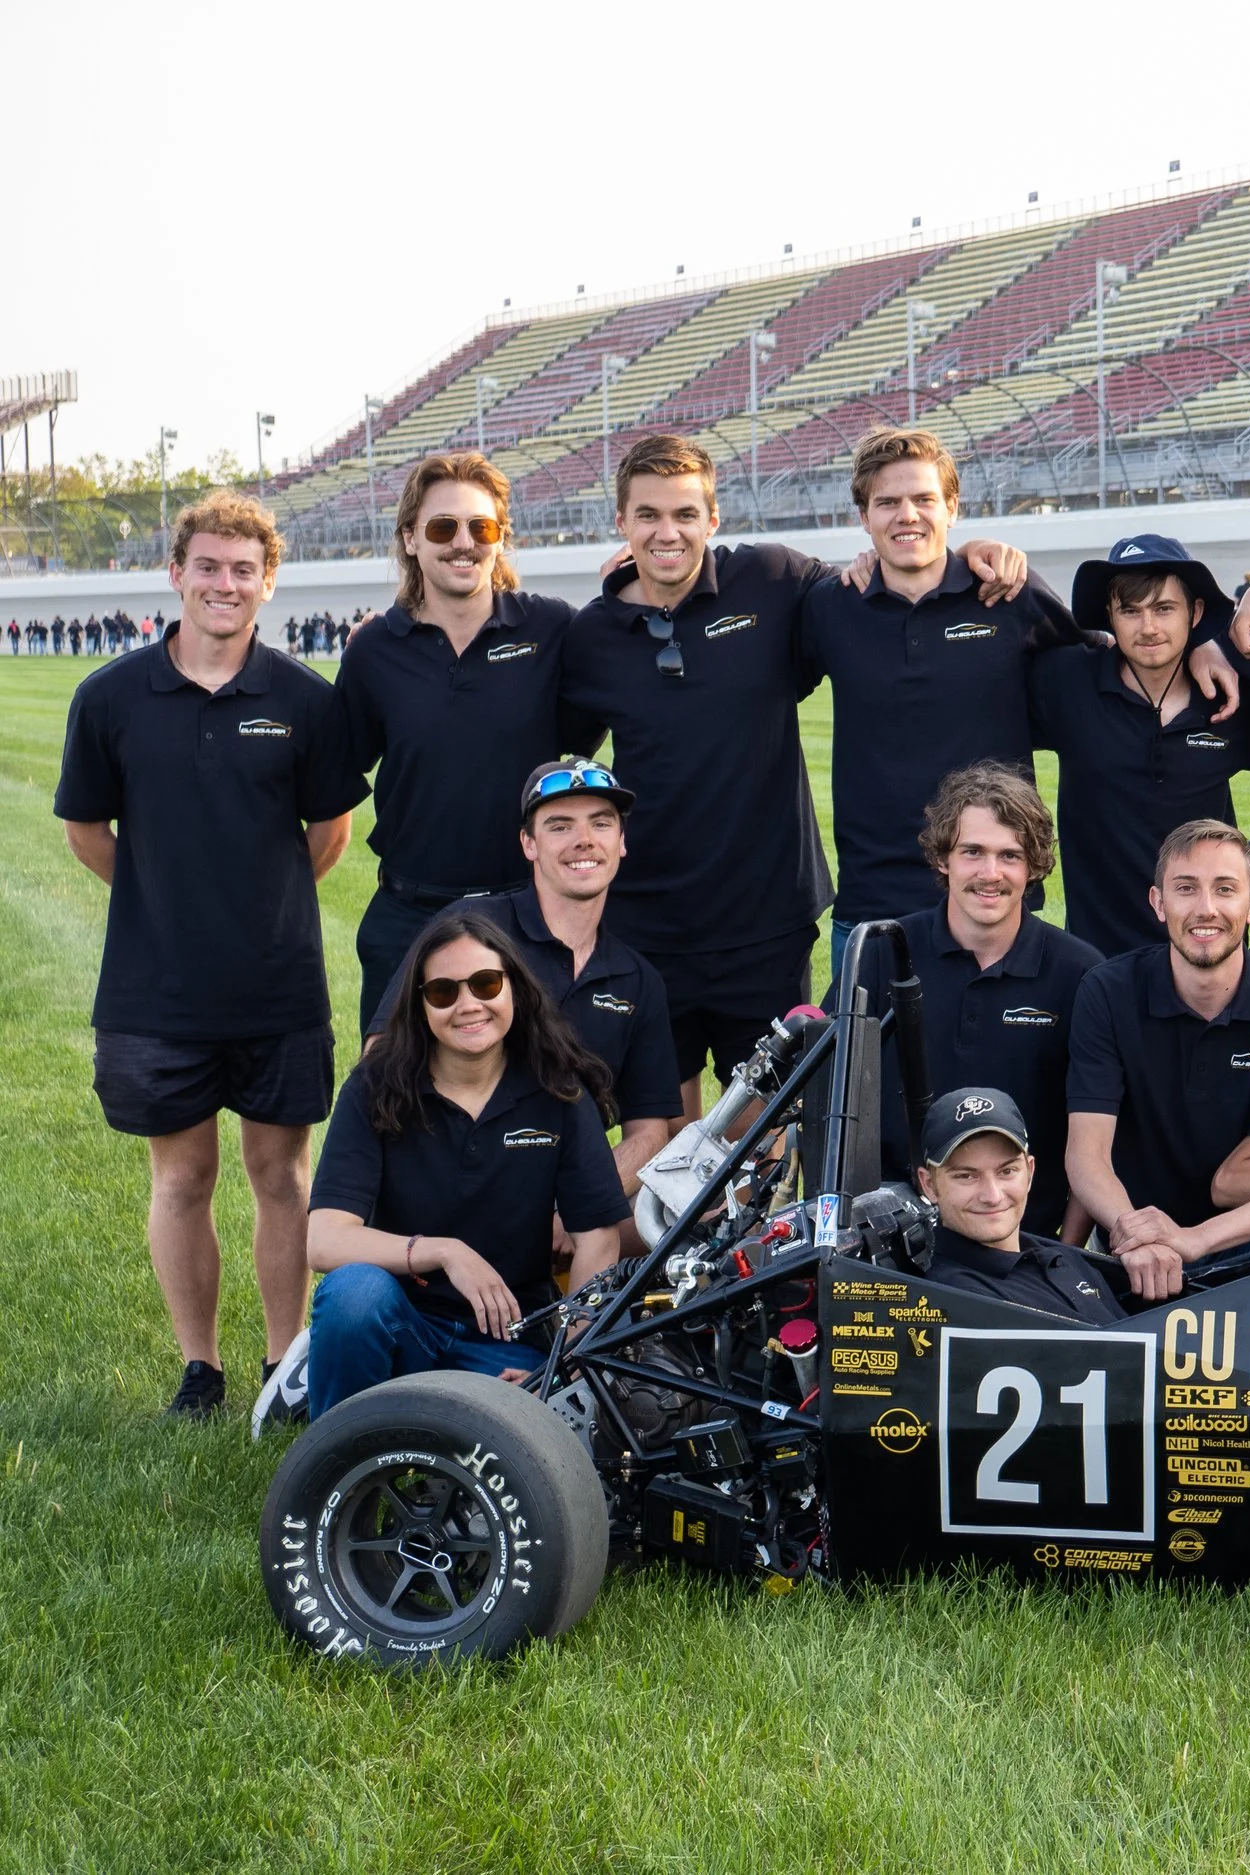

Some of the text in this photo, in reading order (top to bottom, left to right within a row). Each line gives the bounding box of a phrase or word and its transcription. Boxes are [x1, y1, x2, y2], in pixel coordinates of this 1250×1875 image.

[874, 1282, 907, 1291] Country
[832, 1325, 895, 1338] METALEX
[1163, 1308, 1237, 1382] CU
[835, 1350, 895, 1367] PEGASUS
[1167, 1388, 1234, 1406] SKF
[870, 1422, 928, 1437] molex
[1165, 1413, 1248, 1432] wilwood
[976, 1366, 1108, 1504] 21
[1168, 1438, 1199, 1449] NHL
[1202, 1439, 1224, 1448] Nicol
[1171, 1458, 1238, 1472] LINCOLN
[1187, 1474, 1245, 1484] ELECTRIC
[453, 1443, 544, 1595] Hoosier
[1064, 1549, 1153, 1562] COMPOSITE
[1064, 1558, 1142, 1571] ENVISIONS
